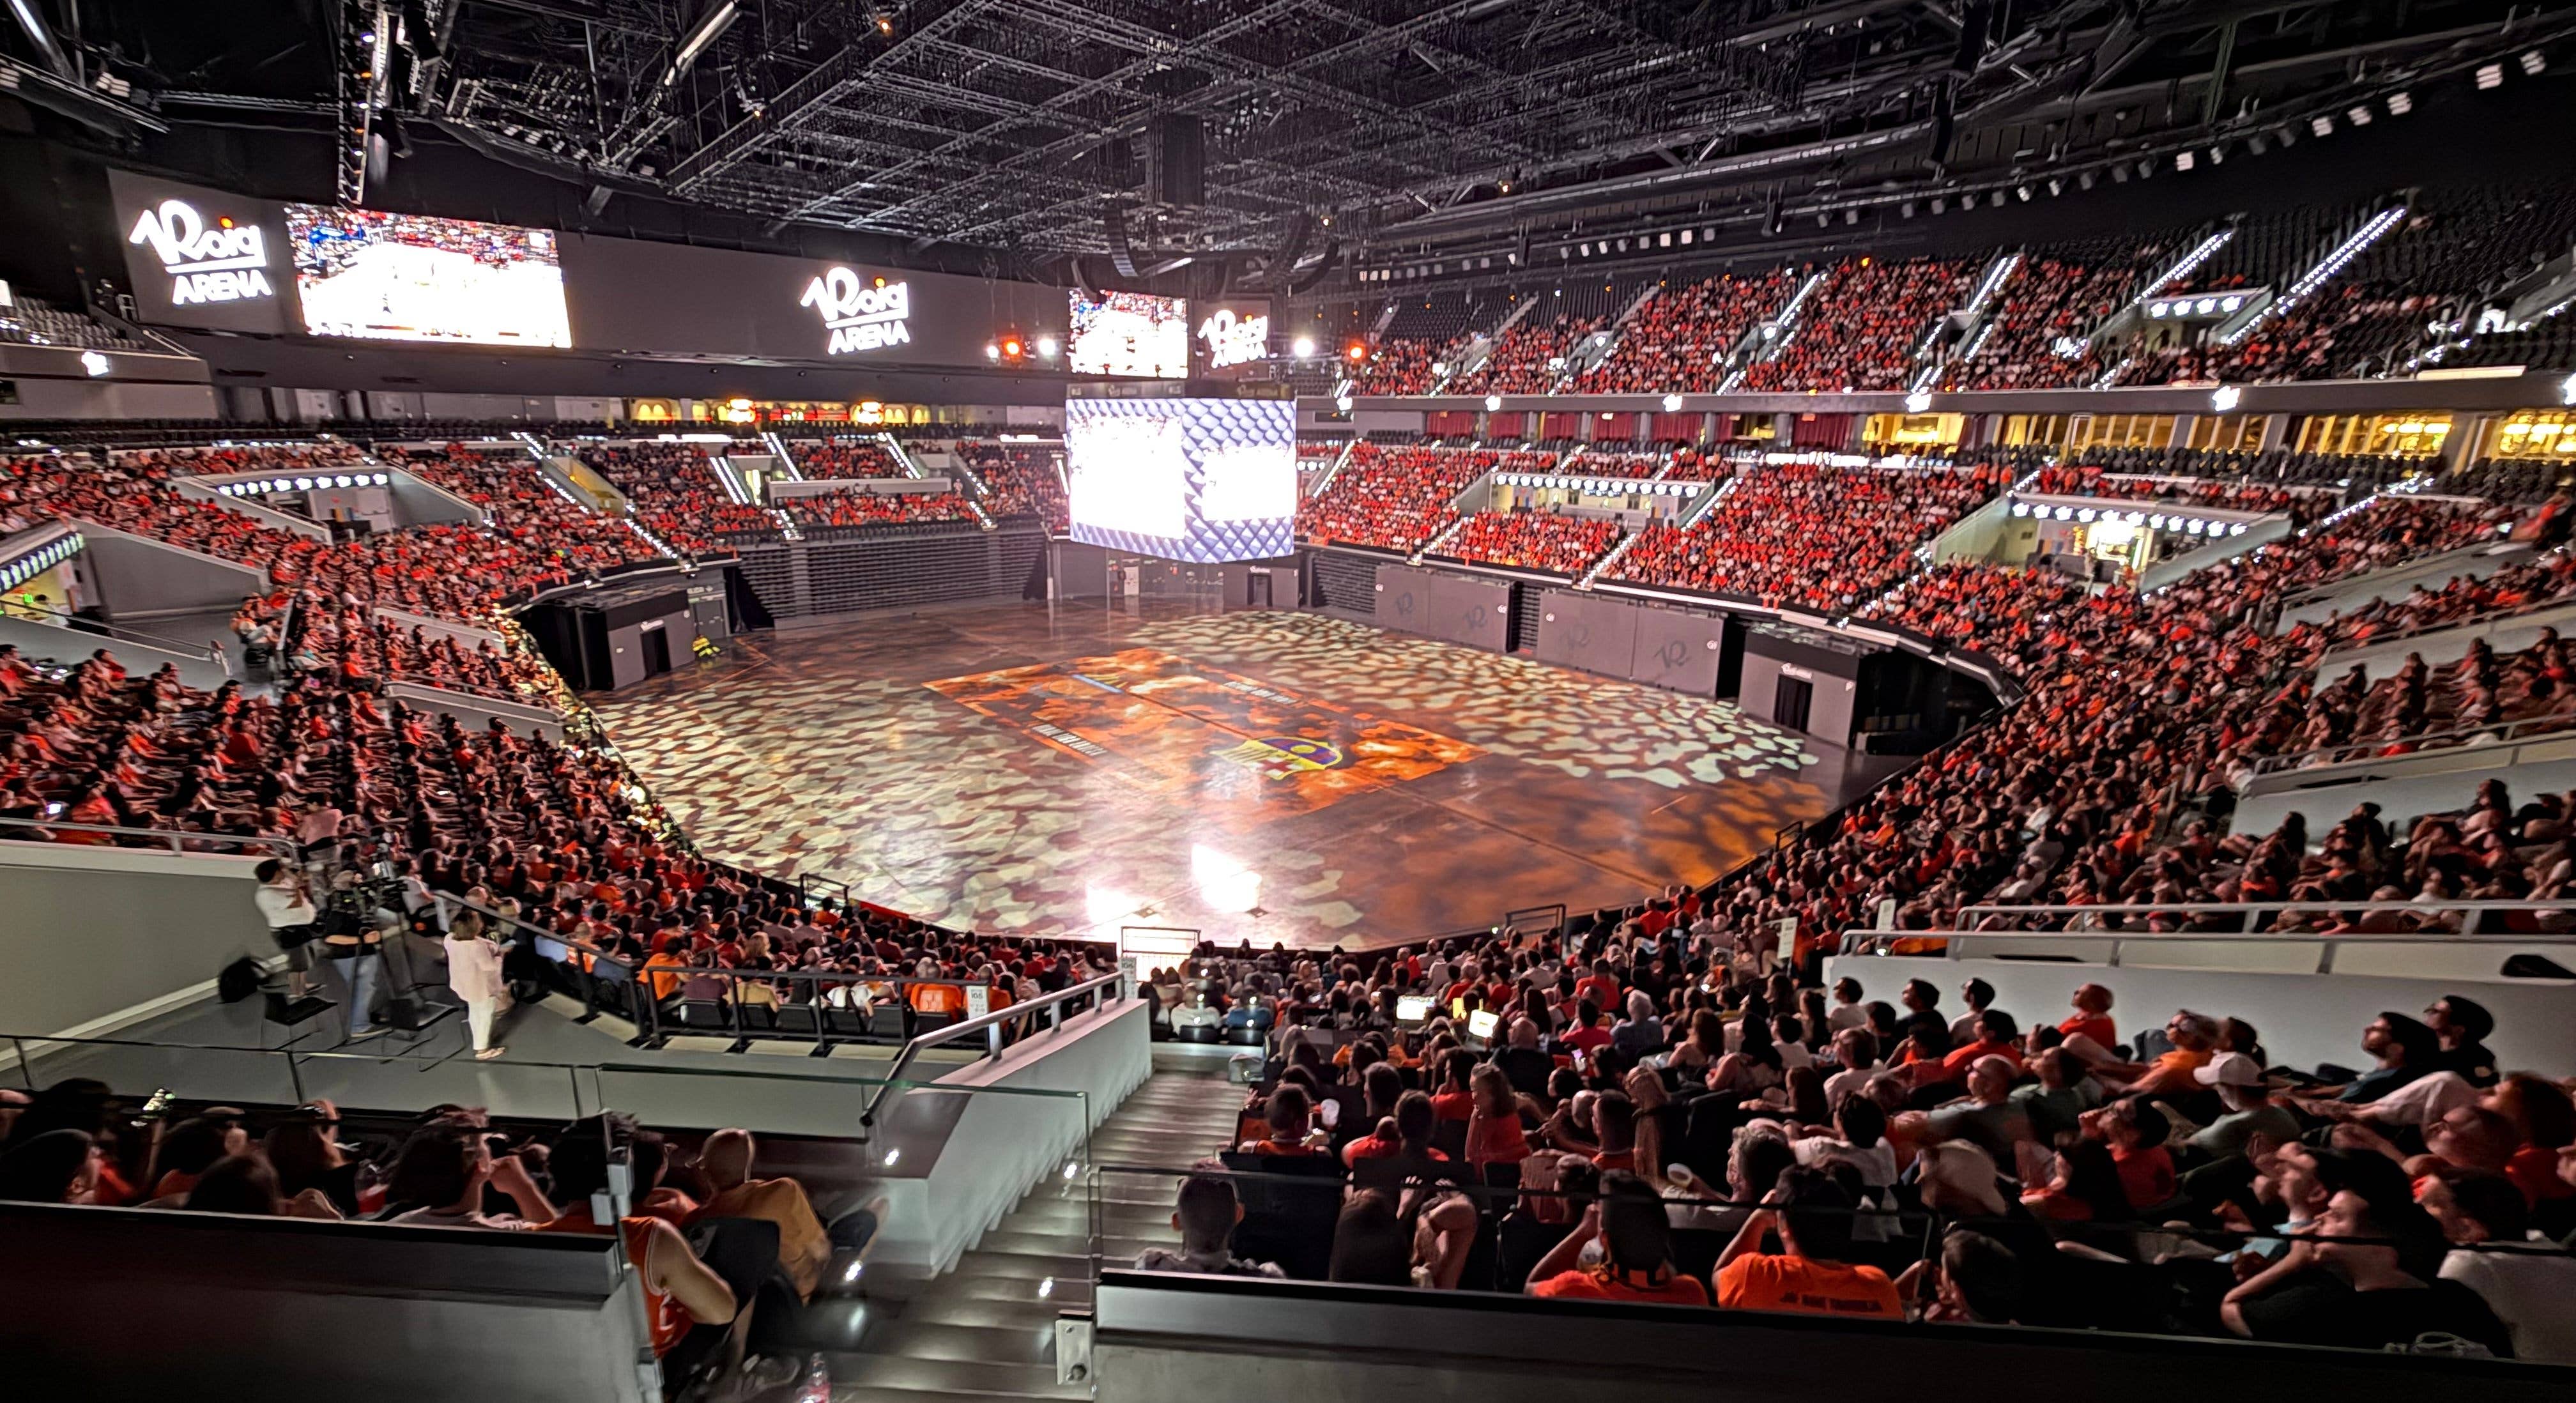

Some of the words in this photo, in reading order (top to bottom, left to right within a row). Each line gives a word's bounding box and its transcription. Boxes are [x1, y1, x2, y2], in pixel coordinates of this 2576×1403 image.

[129, 200, 266, 273] Roig
[172, 269, 273, 305] ARENA
[800, 266, 908, 329] Roig
[828, 319, 910, 355] ARENA
